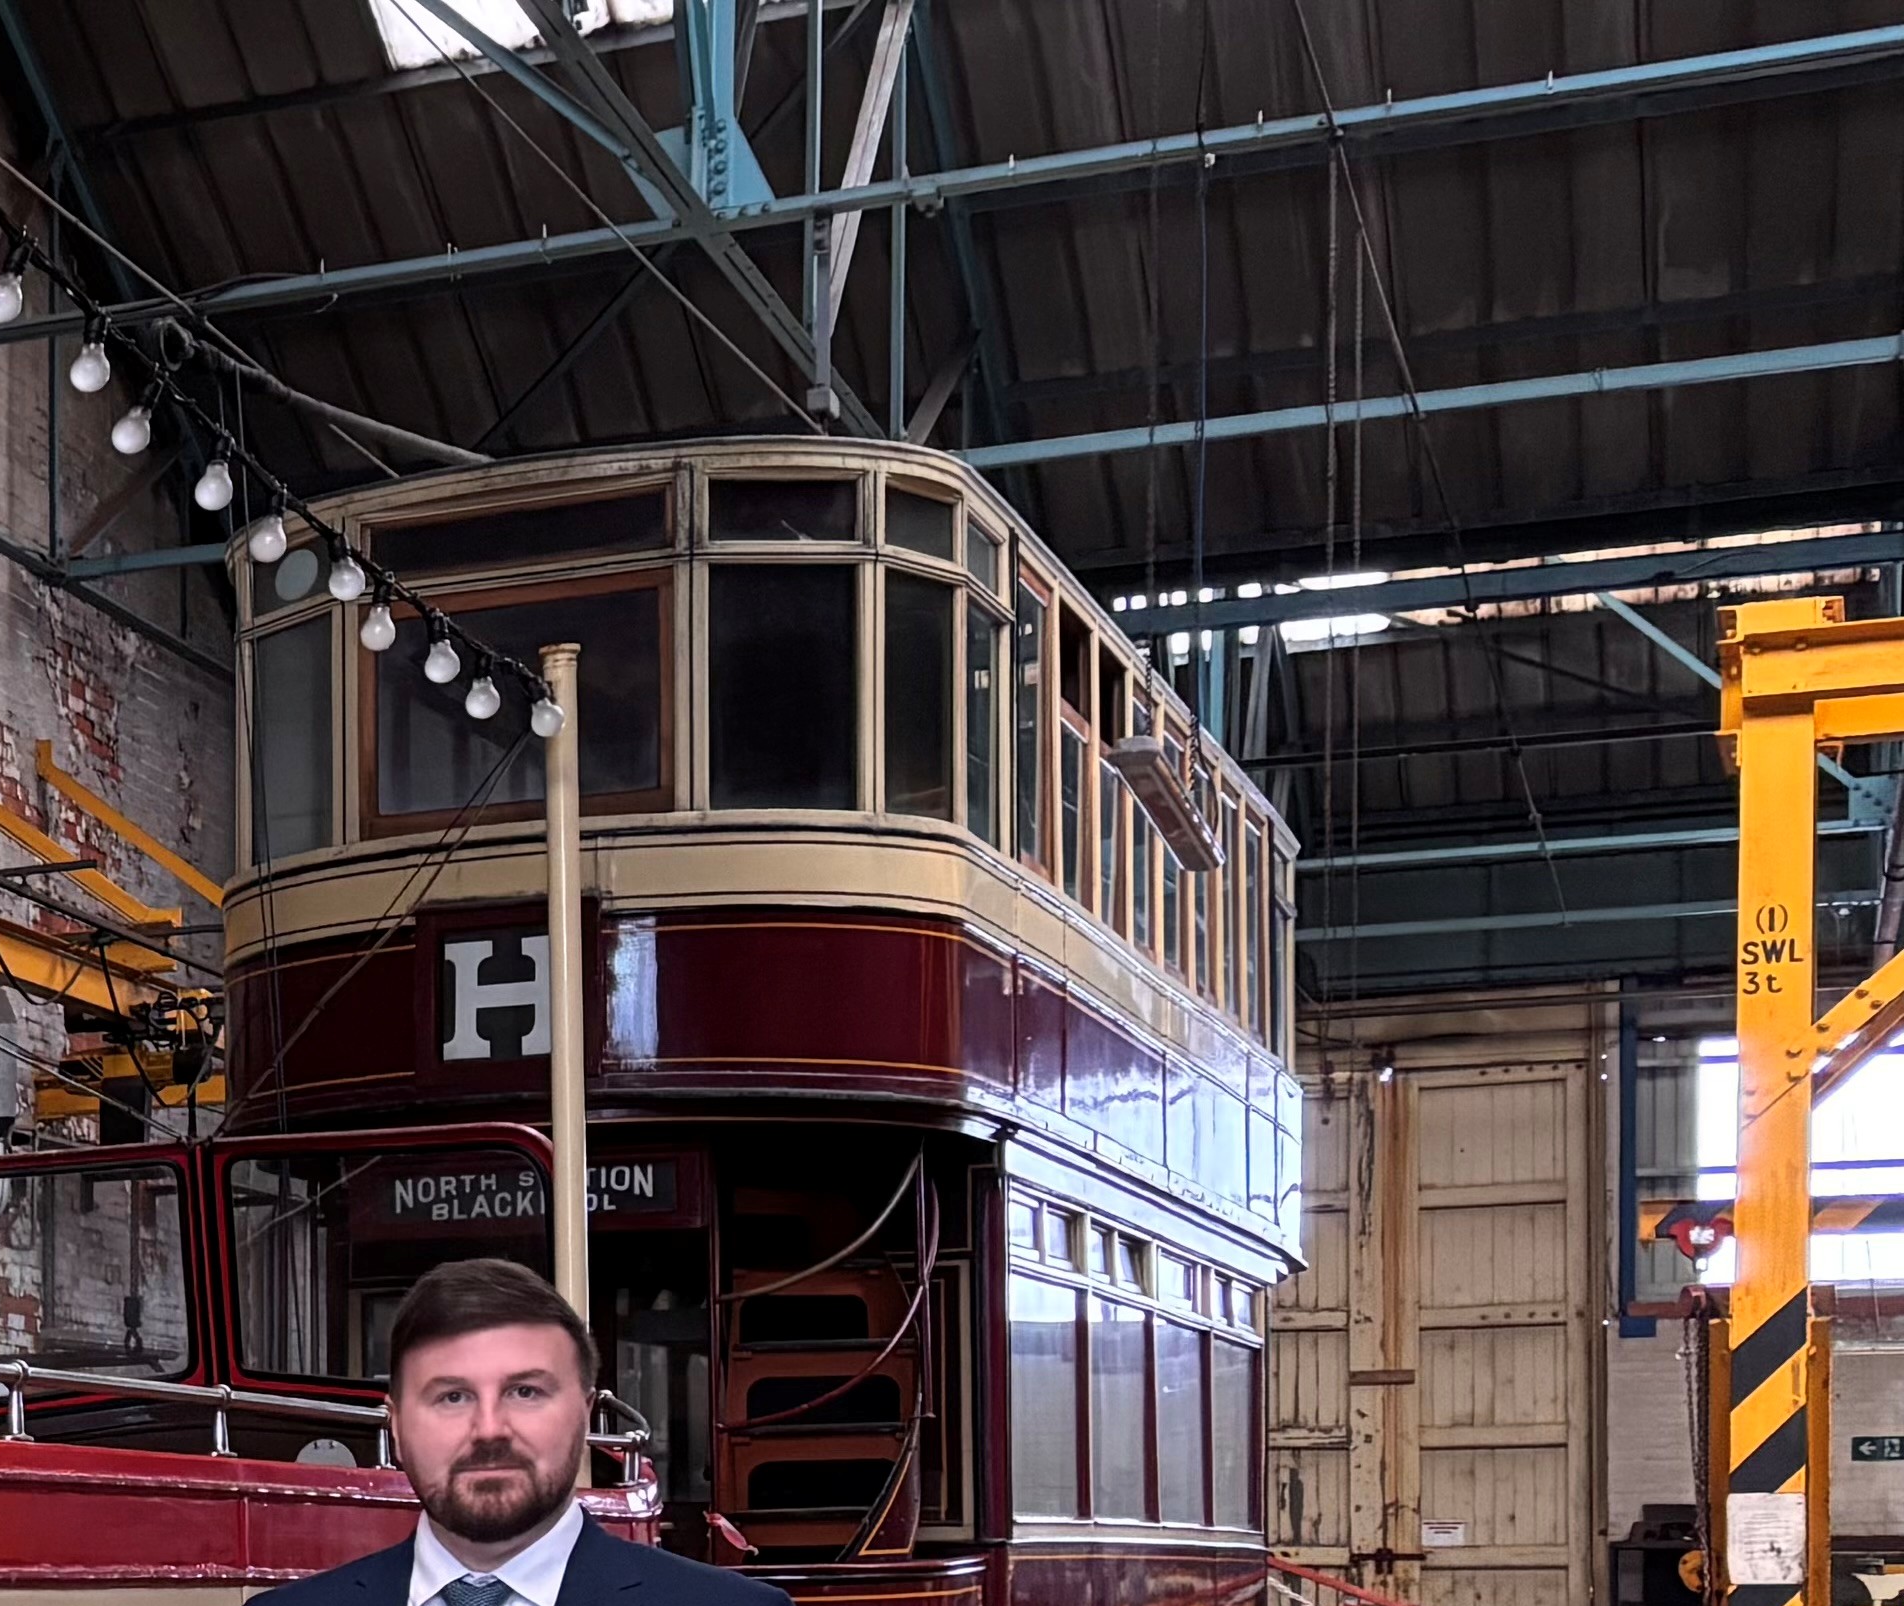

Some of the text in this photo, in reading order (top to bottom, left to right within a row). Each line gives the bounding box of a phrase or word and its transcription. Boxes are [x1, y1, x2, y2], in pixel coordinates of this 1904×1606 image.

[1741, 938, 1804, 966] SWL
[443, 934, 552, 1062] H
[394, 1163, 653, 1214] NORTH SION
[431, 1190, 617, 1222] BLACKOL
